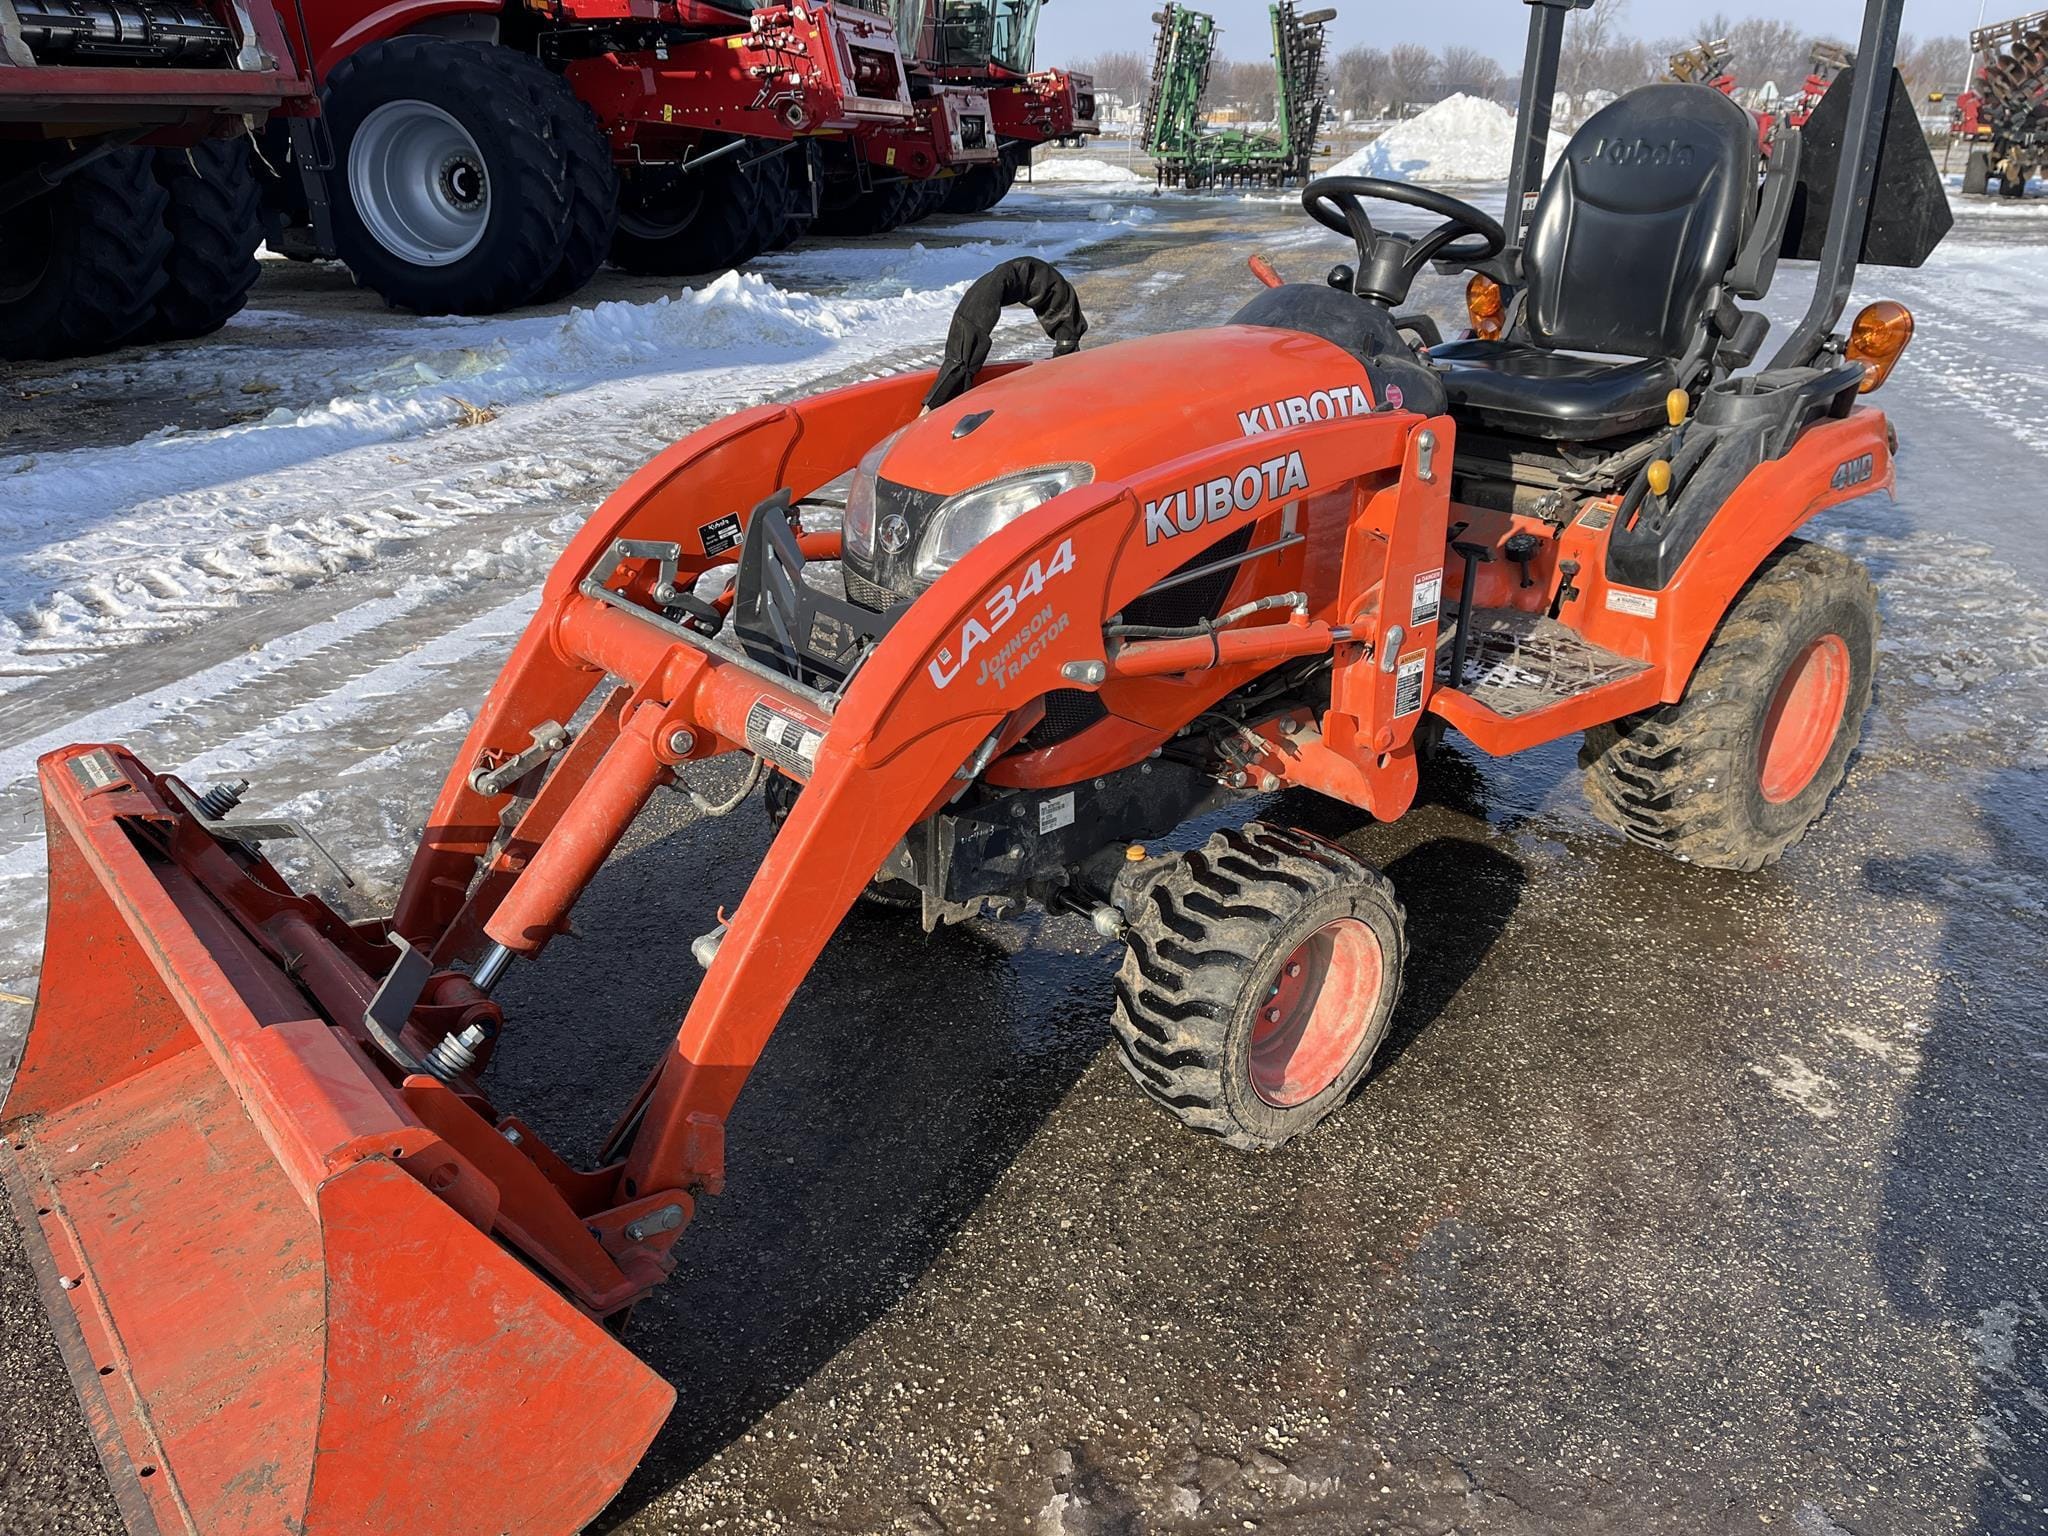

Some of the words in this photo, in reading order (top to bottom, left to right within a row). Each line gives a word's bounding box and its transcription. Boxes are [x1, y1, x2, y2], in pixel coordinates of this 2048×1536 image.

[1595, 138, 1696, 165] Kubota
[1237, 384, 1372, 437] KUBOTA
[1145, 450, 1309, 545] KUBOTA
[1830, 452, 1873, 490] 4WD
[928, 537, 1077, 689] LA344
[976, 603, 1054, 686] JOHNSON
[993, 612, 1071, 690] TRACTOR
